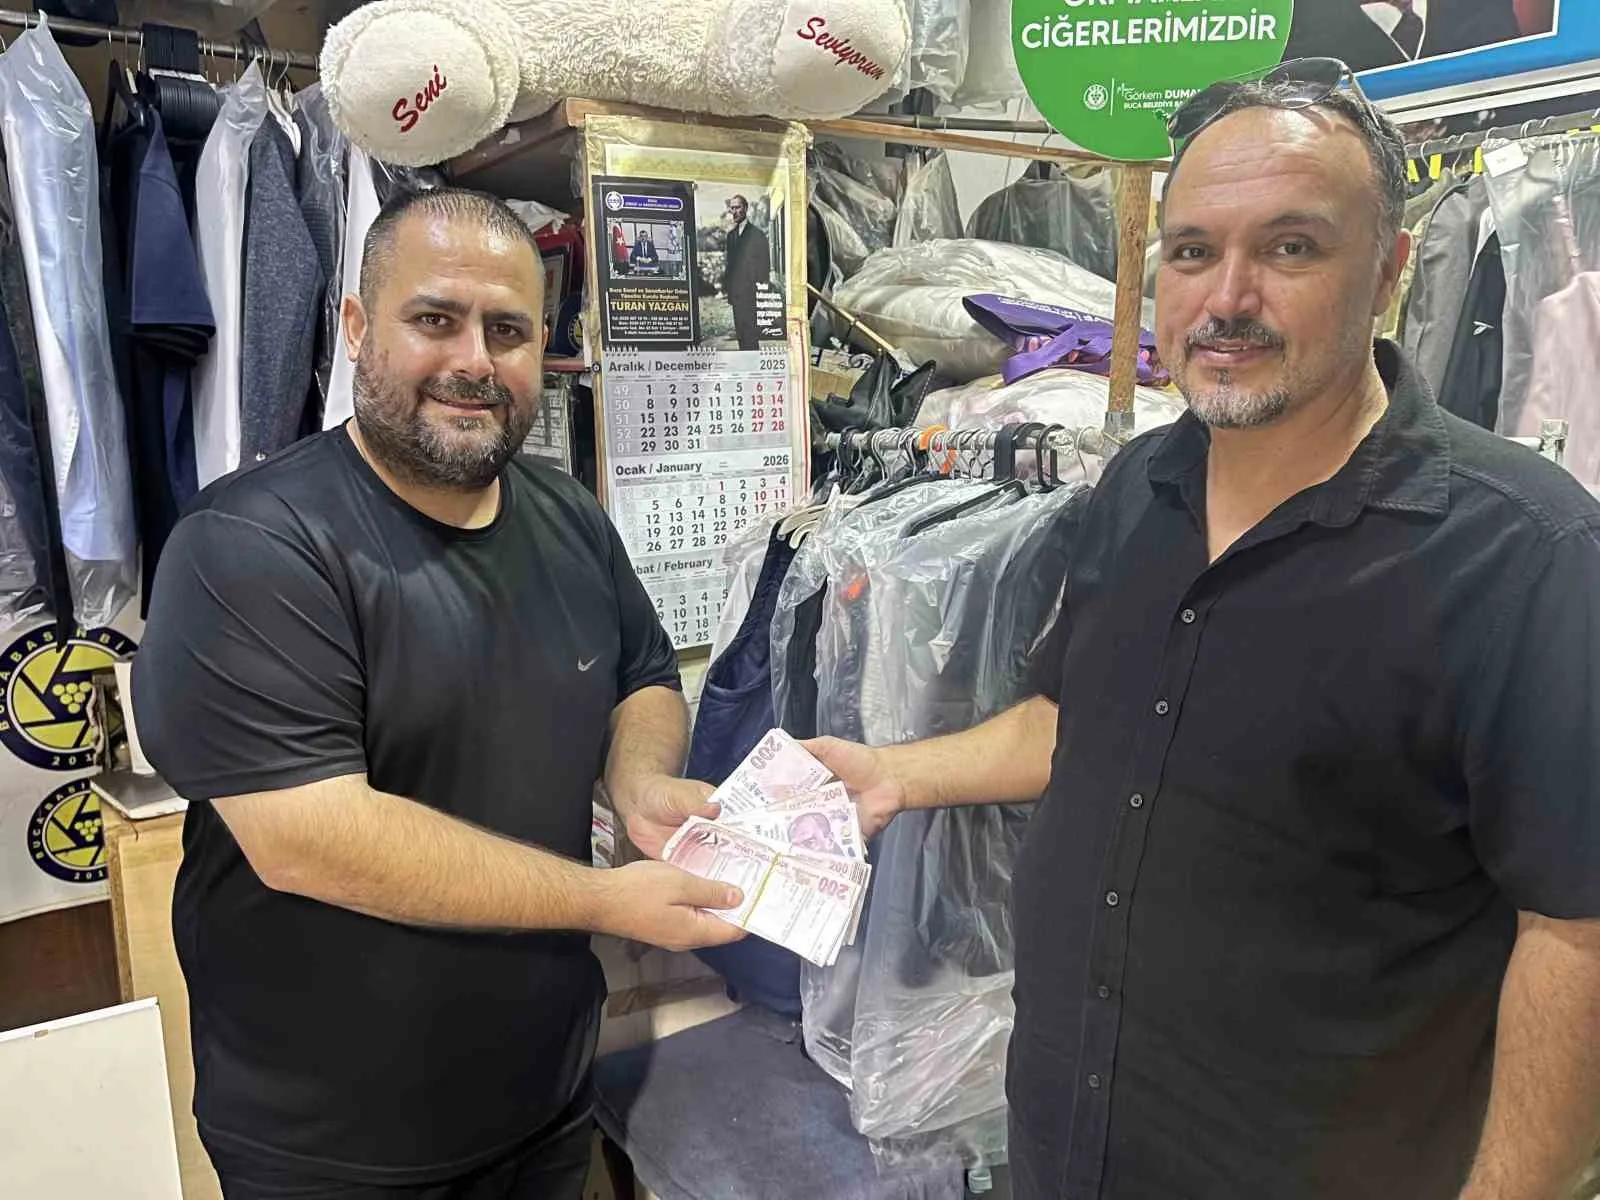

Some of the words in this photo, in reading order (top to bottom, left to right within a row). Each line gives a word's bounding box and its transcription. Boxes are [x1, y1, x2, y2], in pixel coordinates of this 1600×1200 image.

[1020, 7, 1277, 49] CİĞERLERİMİZDİR
[391, 63, 447, 133] Seni
[1164, 88, 1201, 100] DUMA
[609, 301, 646, 311] TURAN
[648, 301, 689, 312] YAZGAN
[608, 360, 646, 372] Aralık
[655, 360, 713, 372] December
[760, 359, 786, 370] 2025
[646, 383, 652, 396] 1
[669, 383, 677, 395] 2
[691, 383, 699, 394] 3
[714, 382, 722, 394] 4
[735, 382, 743, 393] 5
[756, 381, 764, 392] 6
[775, 381, 784, 391] 7
[615, 398, 630, 410] 50
[646, 398, 655, 410] 8
[669, 398, 678, 409] 9
[686, 397, 700, 408] 10
[708, 396, 721, 408] 11
[730, 395, 744, 407] 12
[751, 394, 764, 406] 13
[771, 394, 784, 405] 14
[615, 414, 629, 425] 51
[640, 412, 655, 424] 15
[663, 411, 678, 423] 16
[686, 411, 701, 422] 17
[709, 410, 723, 421] 18
[730, 409, 744, 420] 19
[751, 408, 765, 419] 20
[770, 407, 783, 418] 21
[640, 426, 656, 438] 22
[663, 425, 679, 437] 23
[686, 424, 701, 436] 24
[708, 423, 723, 435] 25
[730, 423, 745, 434] 26
[751, 422, 765, 433] 27
[771, 421, 785, 432] 28
[641, 441, 657, 453] 29
[664, 440, 680, 451] 30
[687, 438, 701, 450] 31
[615, 464, 647, 476] Ocak
[656, 462, 703, 473] January
[762, 454, 789, 467] 2026
[719, 480, 724, 491] 1
[739, 479, 746, 489] 2
[759, 477, 767, 488] 3
[779, 475, 786, 486] 4
[652, 499, 660, 511] 5
[675, 497, 683, 509] 6
[697, 495, 705, 507] 7
[719, 494, 726, 505] 8
[739, 492, 747, 503] 9
[754, 490, 767, 501] 10
[774, 488, 785, 499] 11
[645, 513, 661, 525] 12
[669, 511, 683, 523] 13
[691, 509, 705, 521] 14
[713, 507, 727, 519] 15
[734, 505, 747, 516] 16
[754, 503, 767, 514] 17
[647, 527, 661, 538] 19
[668, 525, 684, 537] 20
[691, 523, 705, 534] 21
[713, 520, 727, 532] 22
[646, 540, 662, 553] 26
[669, 538, 684, 550] 27
[691, 536, 706, 548] 28
[713, 534, 728, 545] 29
[635, 563, 655, 575] bat
[664, 559, 713, 572] February
[656, 598, 664, 609] 2
[679, 594, 687, 606] 3
[701, 591, 708, 602] 4
[722, 588, 729, 600] 5
[657, 611, 665, 622] 9
[673, 608, 687, 620] 10
[695, 604, 707, 617] 11
[673, 621, 688, 633] 17
[695, 618, 709, 629] 18
[10, 628, 88, 663] BASN
[673, 634, 688, 646] 24
[695, 631, 709, 642] 25
[51, 752, 94, 766] 201
[750, 735, 783, 770] 200
[822, 788, 842, 801] 200
[72, 869, 105, 881] 201
[829, 860, 850, 874] 200
[818, 876, 850, 900] 200
